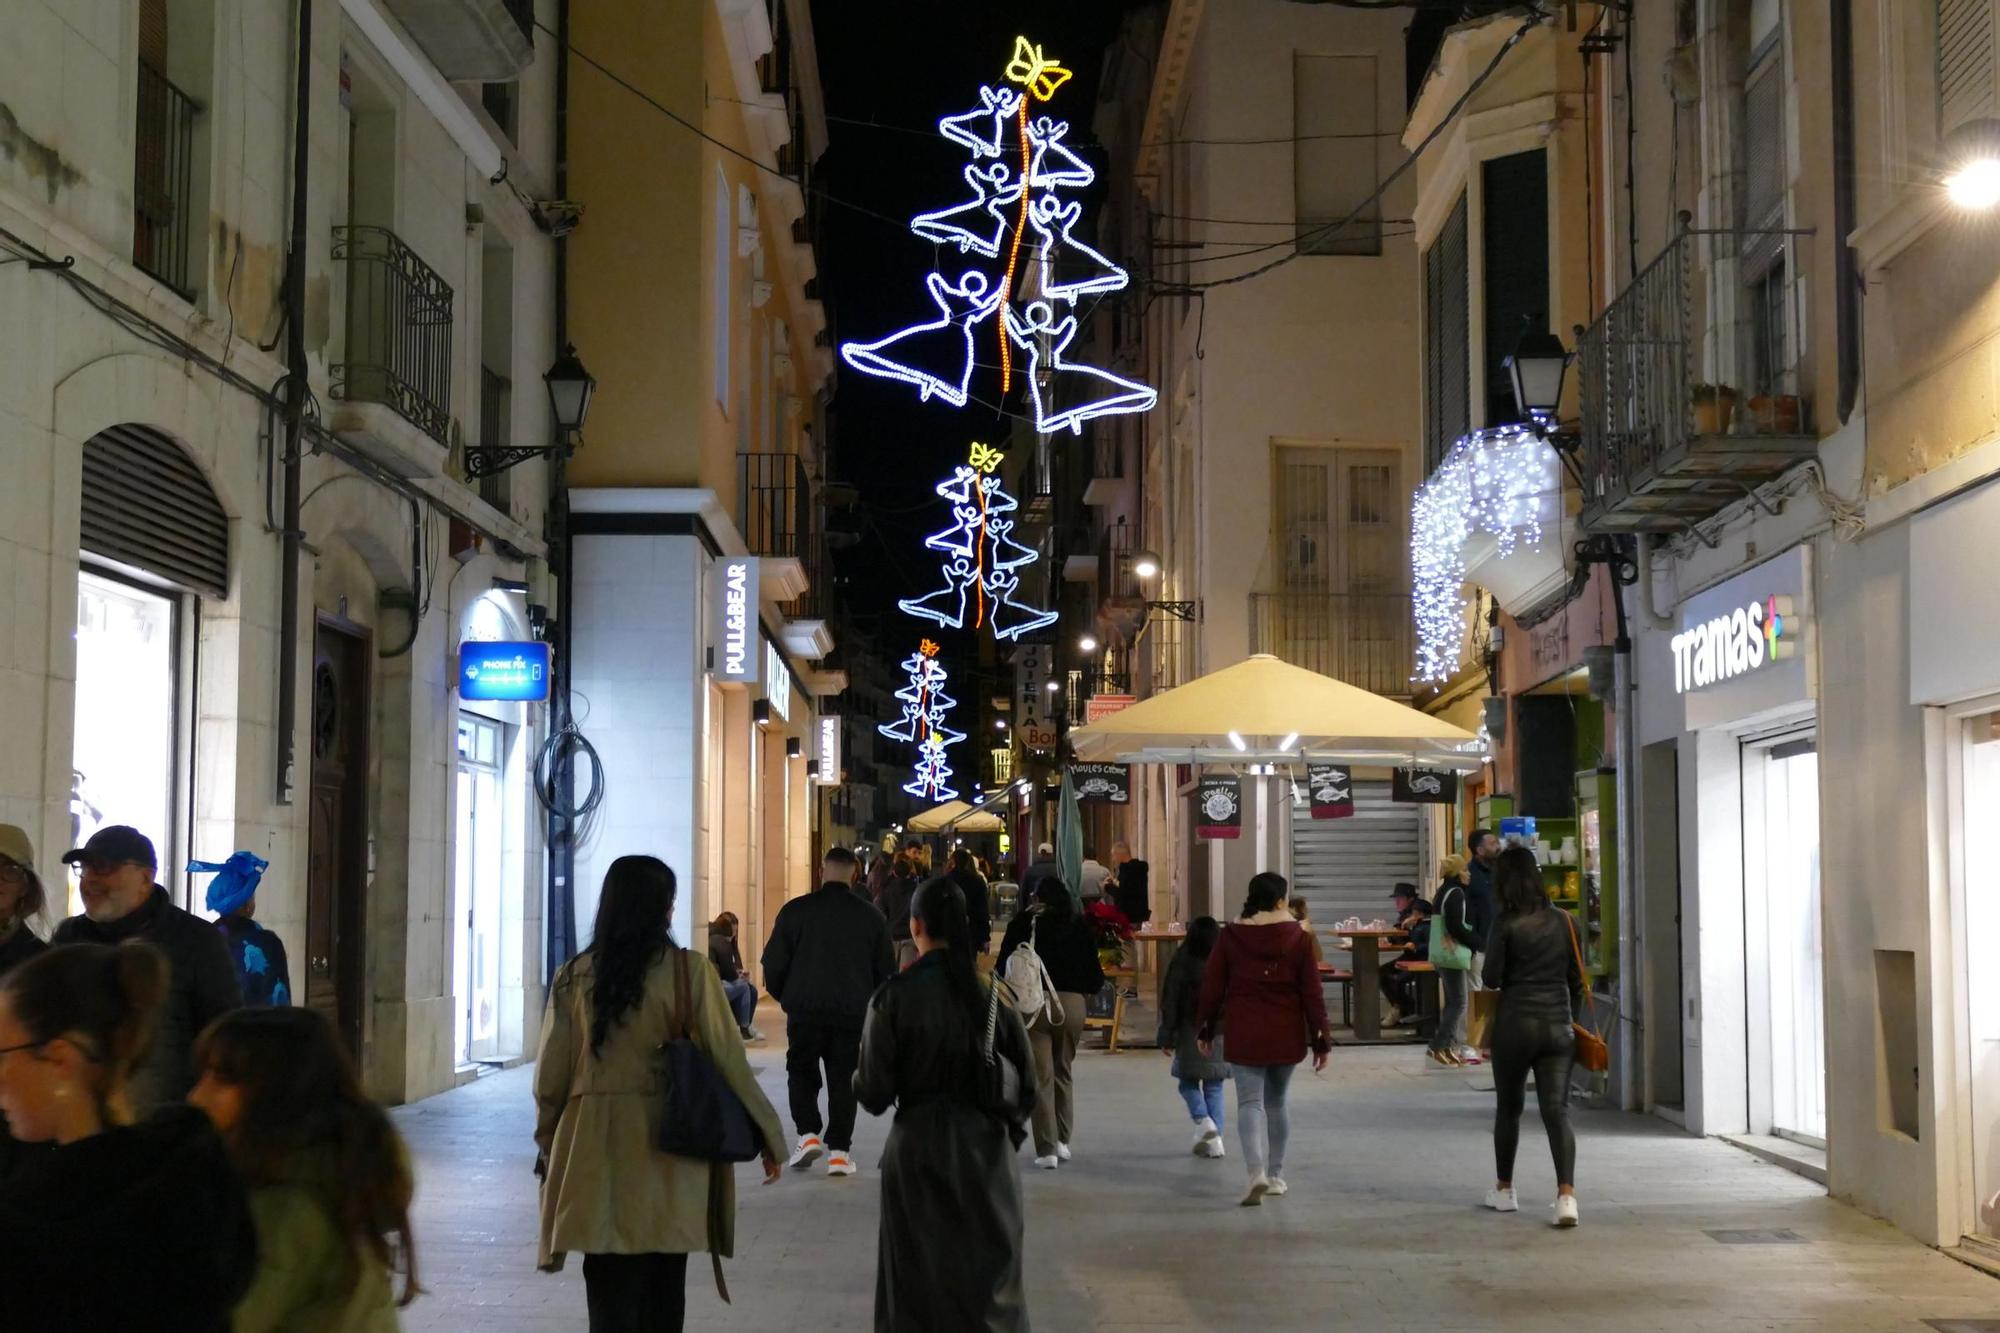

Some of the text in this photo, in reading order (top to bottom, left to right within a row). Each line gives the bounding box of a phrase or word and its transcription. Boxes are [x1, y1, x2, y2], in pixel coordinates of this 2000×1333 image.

[725, 563, 747, 675] PULL&BEAR
[1671, 601, 1765, 694] Tramas
[482, 659, 526, 670] PHONE FIX
[1023, 646, 1038, 727] JOIERIA
[822, 719, 835, 782] PULL&BEAR
